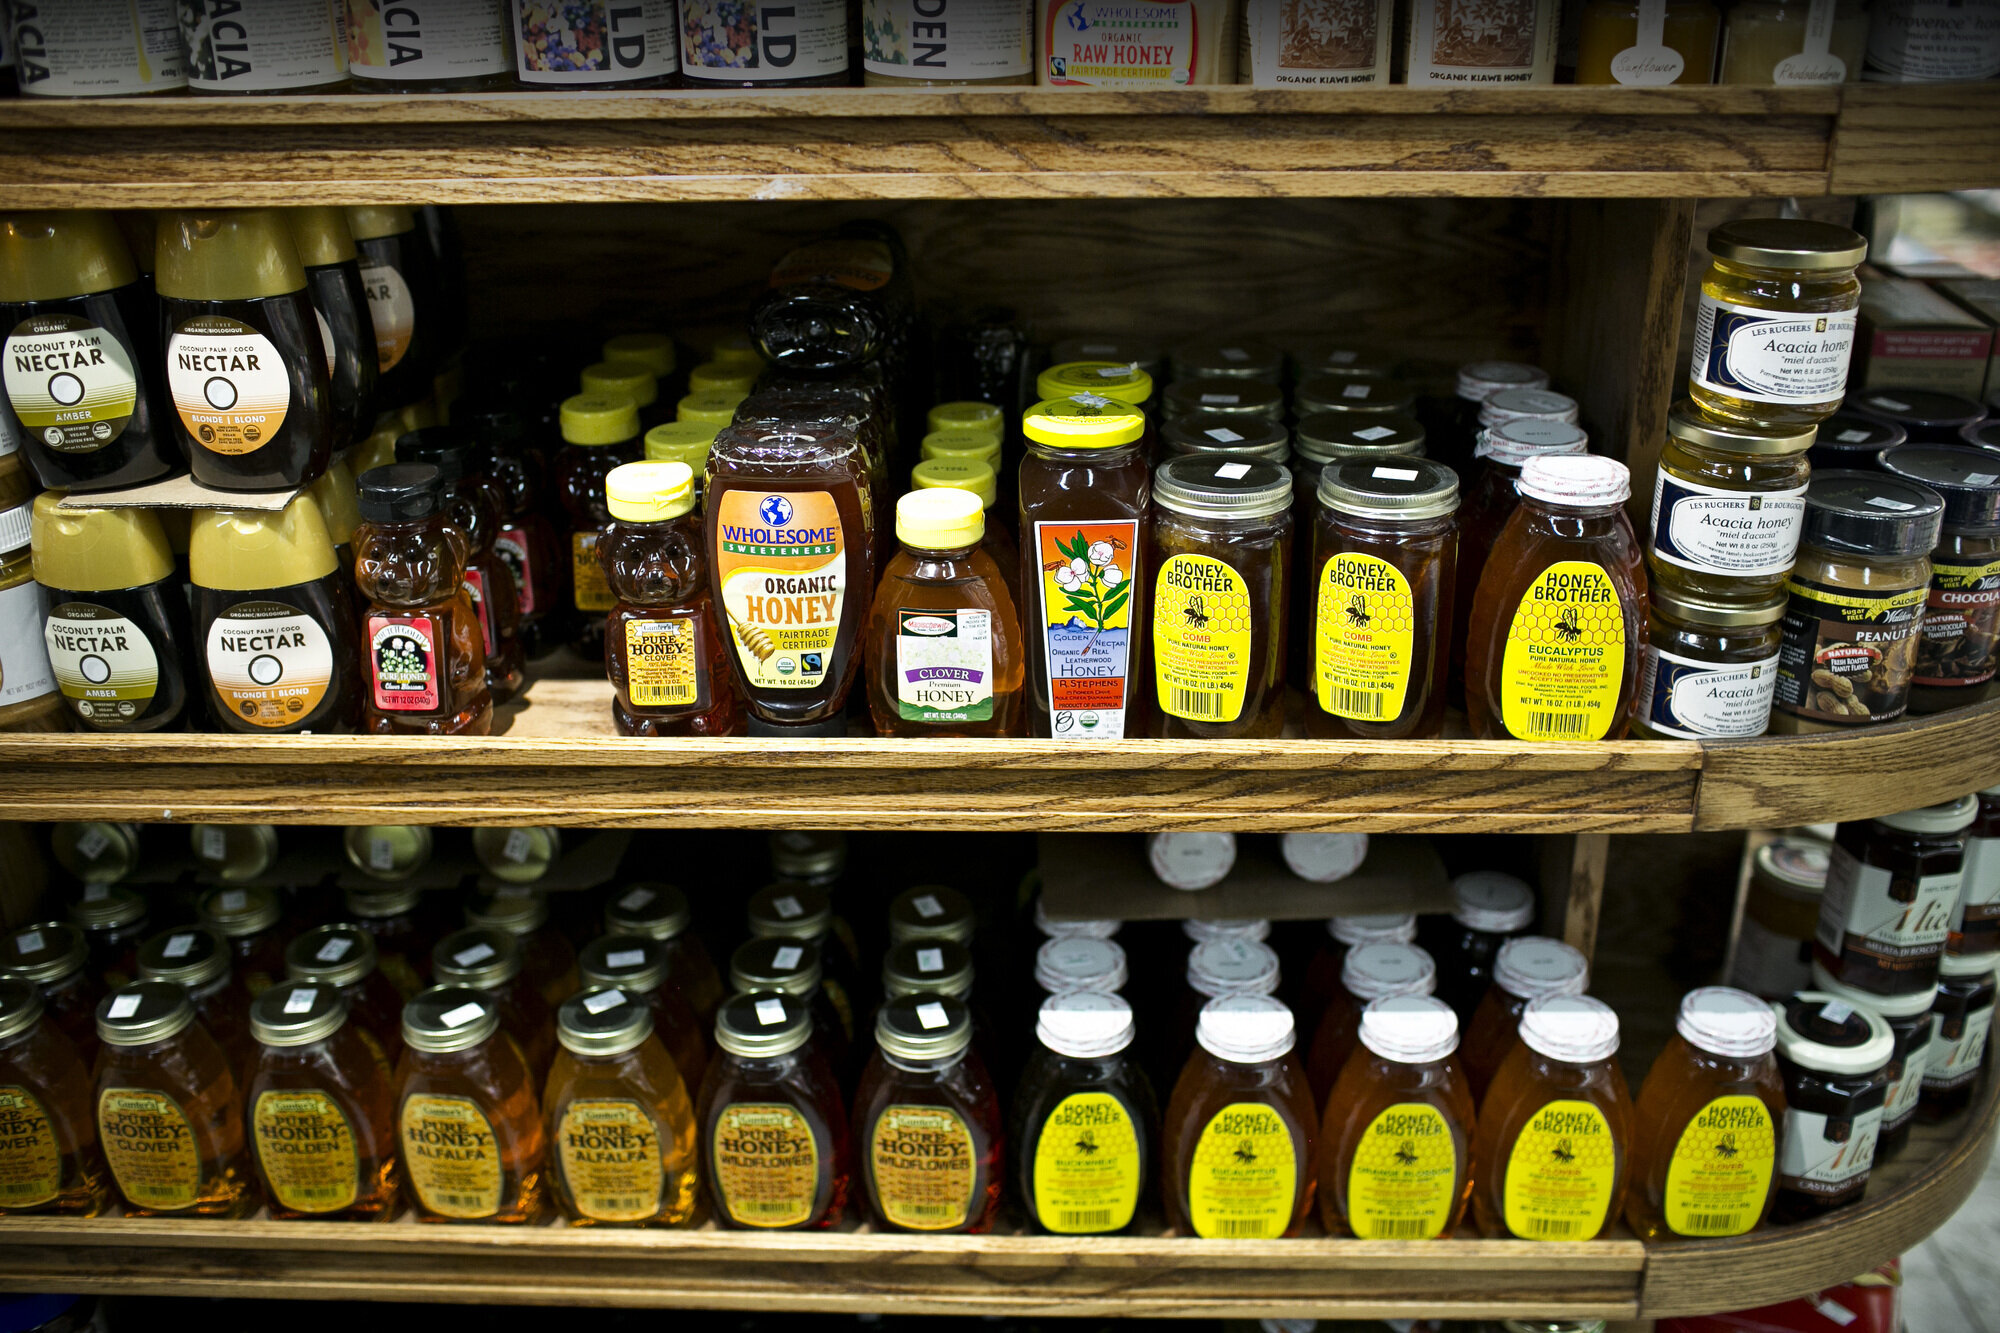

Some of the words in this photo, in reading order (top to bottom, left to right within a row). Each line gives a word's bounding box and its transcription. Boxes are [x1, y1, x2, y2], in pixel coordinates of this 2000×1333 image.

[1096, 7, 1178, 19] WHOLESOME
[1101, 33, 1141, 42] ORGANIC
[1073, 44, 1108, 64] RAW
[1113, 46, 1174, 65] HONEY
[1071, 67, 1118, 77] FAIRTRADE
[1121, 68, 1167, 78] CERTIFIED
[1430, 72, 1468, 81] ORGANIC
[1470, 73, 1502, 82] KIAWE
[1503, 73, 1532, 81] HONEY
[1276, 75, 1316, 84] ORGANIC
[1319, 76, 1349, 84] KIAWE
[1350, 74, 1375, 83] HONEY
[33, 323, 68, 333] ORGANIC
[1752, 329, 1767, 337] LES
[1769, 325, 1811, 334] RUCHERS
[12, 342, 66, 353] COCONUT
[70, 336, 101, 349] PALM
[1763, 339, 1817, 353] Acacia
[15, 349, 105, 372] NECTAR
[178, 354, 261, 372] NECTAR
[55, 411, 93, 422] AMBER
[191, 415, 223, 424] BLONDE
[234, 415, 267, 424] BLOND
[1689, 502, 1703, 510] LES
[1700, 514, 1752, 529] Acacia
[1757, 517, 1793, 529] honey
[722, 525, 836, 544] WHOLESOME
[729, 543, 831, 555] SWEETENERS
[1174, 560, 1223, 578] HONEY
[1337, 558, 1386, 578] HONEY
[765, 575, 837, 595] ORGANIC
[1167, 572, 1233, 592] BROTHER
[1330, 570, 1395, 591] BROTHER
[1546, 572, 1603, 588] HONEY
[1534, 586, 1611, 603] BROTHER
[746, 594, 837, 624] HONEY
[1841, 608, 1865, 616] Sugar
[1925, 615, 1964, 624] NATURAL
[52, 624, 93, 635] COCONUT
[98, 626, 126, 634] PALM
[1937, 621, 1967, 631] CHOCOLATE
[779, 629, 830, 639] FAIRTRADE
[1182, 632, 1211, 643] COMB
[1344, 631, 1372, 642] COMB
[1856, 629, 1907, 642] PEANUT
[1947, 629, 1964, 637] FLAVOR
[54, 634, 129, 652] NECTAR
[221, 633, 306, 652] NECTAR
[642, 636, 676, 644] PURE
[782, 640, 827, 650] CERTIFIED
[1095, 640, 1125, 649] NECTAR
[1181, 640, 1207, 650] NATURAL
[1343, 641, 1368, 650] NATURAL
[630, 643, 685, 655] HONEY
[1529, 645, 1604, 656] EUCALYPTUS
[1827, 649, 1868, 658] NATURAL
[1831, 657, 1846, 666] FRESH
[1847, 657, 1869, 665] ROASTED
[1061, 664, 1116, 677] HONEY
[1831, 664, 1850, 672] PEANUT
[379, 672, 399, 680] PURE
[400, 672, 427, 680] HONEY
[919, 669, 969, 680] CLOVER
[1711, 673, 1748, 683] RUCHERS
[797, 678, 817, 686] (454g)
[1200, 681, 1206, 689] (1
[1219, 682, 1233, 690] 454g
[1360, 681, 1366, 689] (1
[1380, 682, 1394, 690] 454g
[279, 688, 309, 696] BLOND
[917, 690, 974, 702] HONEY
[1706, 687, 1753, 698] Acacia
[1566, 700, 1572, 708] (1
[1587, 701, 1601, 709] 454g
[1064, 1103, 1112, 1115] HONEY
[1709, 1105, 1758, 1118] HONEY
[118, 1114, 164, 1125] PURE
[275, 1115, 323, 1127] PURE
[1055, 1113, 1121, 1126] BROTHER
[1224, 1113, 1272, 1125] HONEY
[1386, 1114, 1435, 1126] HONEY
[1545, 1111, 1594, 1126] HONEY
[1698, 1116, 1764, 1129] BROTHER
[106, 1122, 184, 1139] HONEY
[262, 1123, 342, 1141] HONEY
[422, 1119, 467, 1134] PURE
[584, 1125, 632, 1136] PURE
[1214, 1123, 1280, 1135] BROTHER
[1376, 1123, 1442, 1136] BROTHER
[1534, 1120, 1601, 1135] BROTHER
[409, 1127, 489, 1147] HONEY
[569, 1133, 650, 1149] HONEY
[739, 1129, 787, 1141] PURE
[898, 1132, 945, 1143] PURE
[118, 1140, 180, 1152] CLOVER
[272, 1141, 339, 1154] GOLDEN
[724, 1138, 807, 1154] HONEY
[881, 1139, 965, 1156] HONEY
[417, 1145, 486, 1160] ALFALFA
[576, 1151, 647, 1163] ALFALFA
